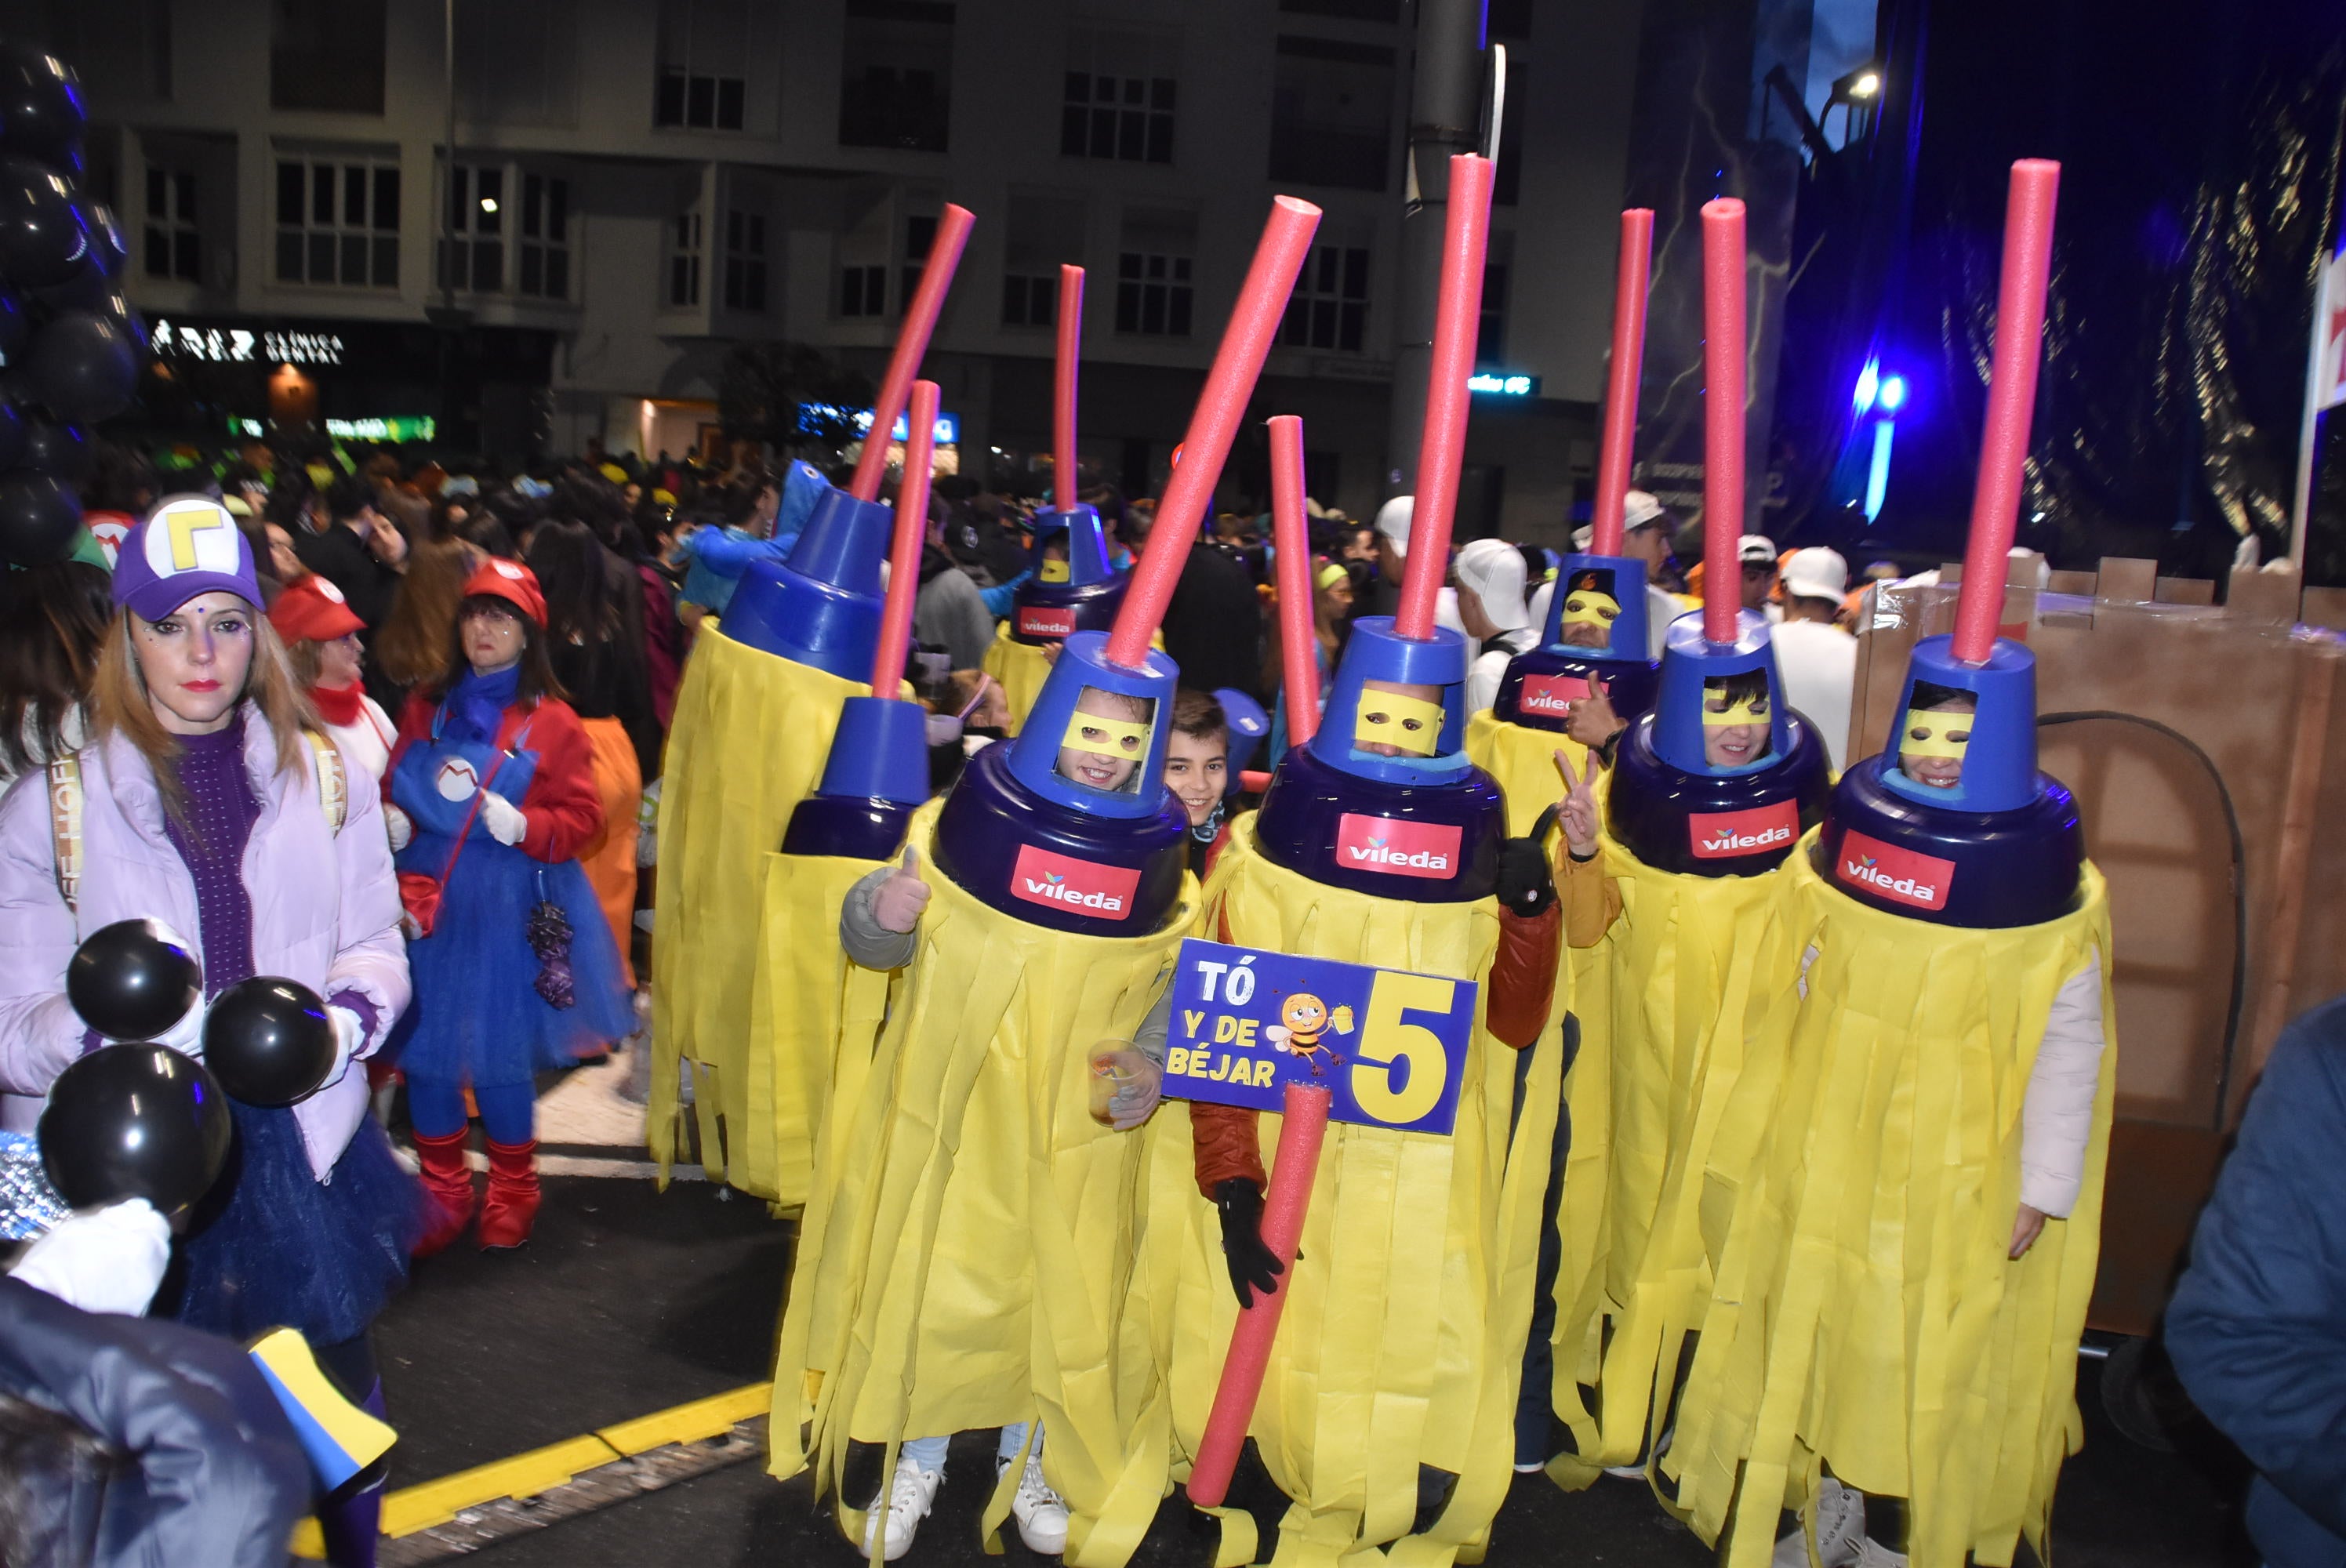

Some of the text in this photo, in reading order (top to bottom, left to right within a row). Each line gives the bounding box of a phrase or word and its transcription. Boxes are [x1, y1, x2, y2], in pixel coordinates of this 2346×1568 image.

[1025, 622, 1070, 633] vileda
[1349, 847, 1447, 869] vileda
[1701, 828, 1791, 851] vileda
[1026, 878, 1123, 911] vileda
[1847, 859, 1934, 902] vileda
[1198, 955, 1256, 1006] TÓ
[1184, 1009, 1259, 1047] Y DE
[1351, 970, 1455, 1123] 5
[1166, 1042, 1276, 1088] BÉJAR
